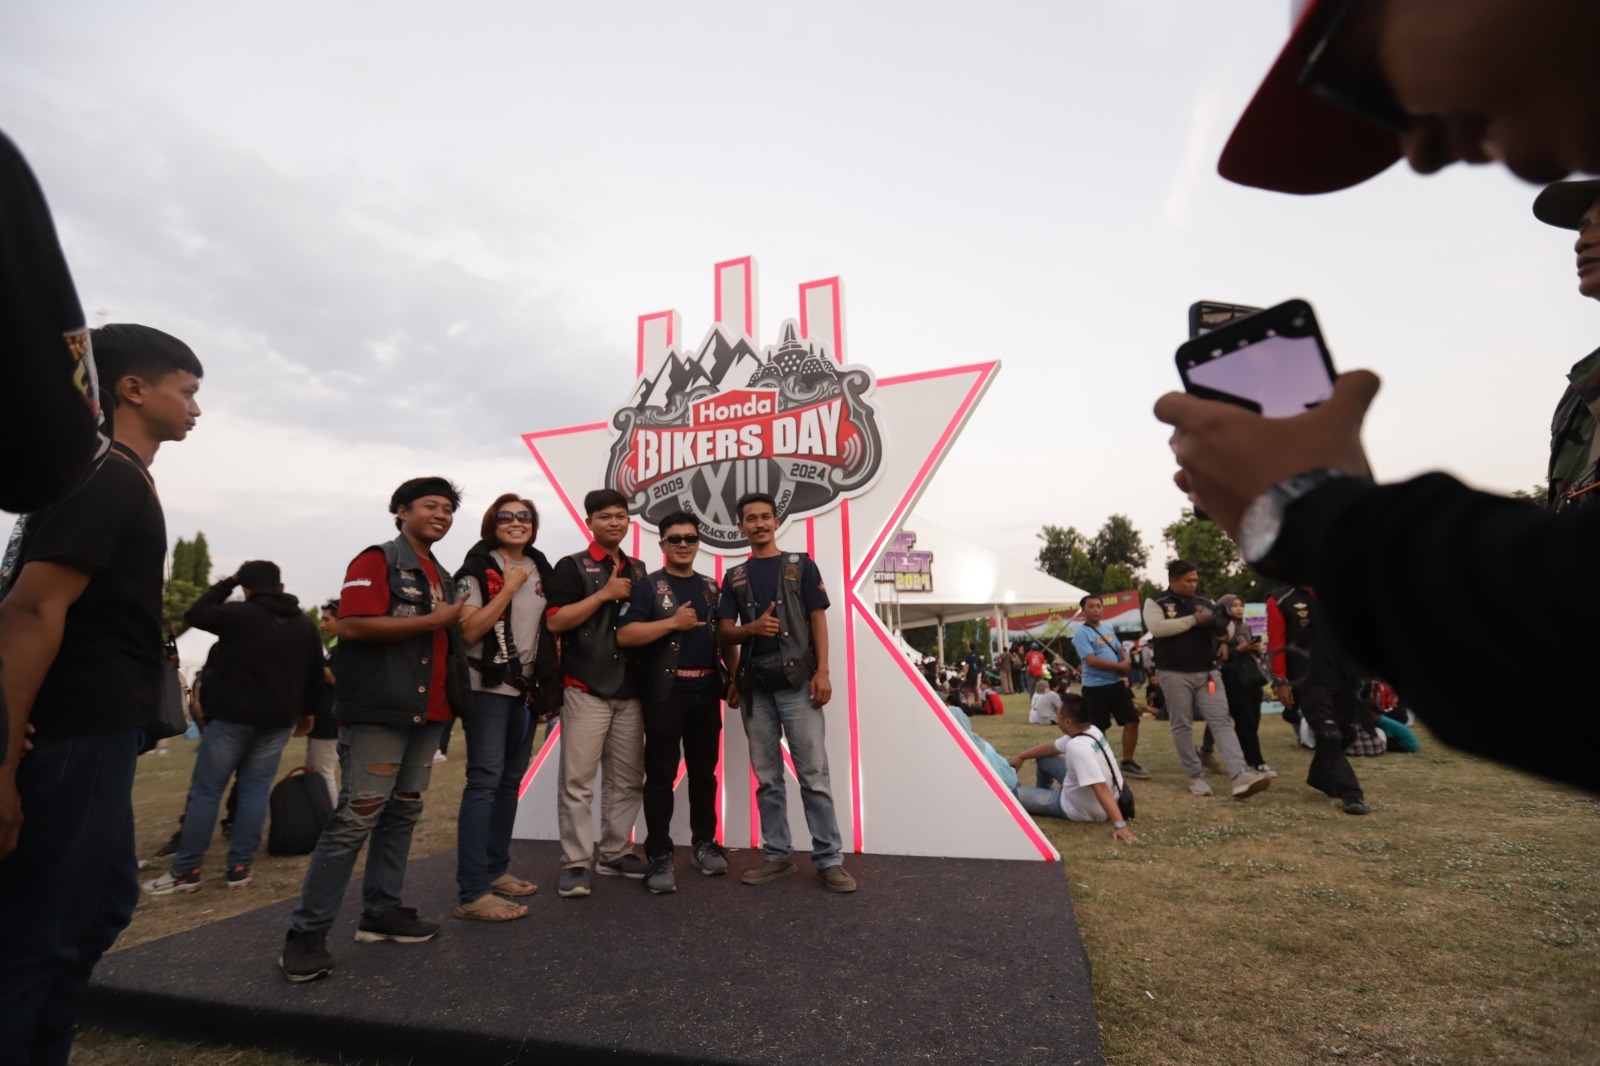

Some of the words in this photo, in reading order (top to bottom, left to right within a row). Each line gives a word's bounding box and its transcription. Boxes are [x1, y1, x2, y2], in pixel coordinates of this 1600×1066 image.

[699, 393, 772, 424] Honda
[636, 423, 764, 483] BIKERS
[772, 398, 843, 457] DAY
[789, 462, 827, 481] 2024
[652, 476, 685, 499] 2009
[727, 530, 740, 540] OF
[895, 572, 932, 591] 2024
